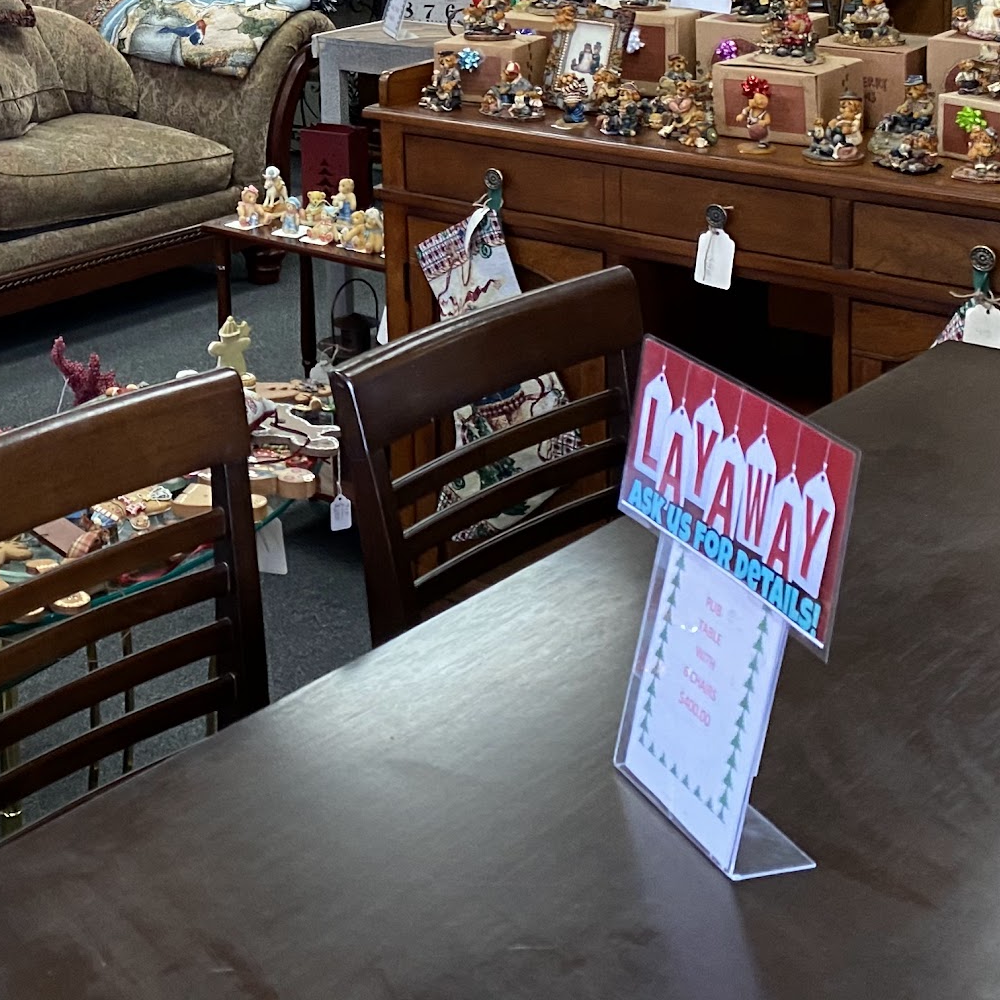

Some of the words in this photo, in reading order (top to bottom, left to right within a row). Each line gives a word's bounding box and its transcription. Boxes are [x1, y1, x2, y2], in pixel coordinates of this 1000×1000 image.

[424, 5, 435, 19] 7
[641, 397, 830, 582] LAYAWAY
[627, 479, 662, 526] ASK
[665, 507, 693, 543] US
[694, 520, 734, 572] FOR
[706, 596, 722, 617] PUB
[699, 619, 722, 646] TABLE
[696, 646, 716, 671] WITH
[683, 666, 689, 678] 6
[690, 671, 717, 702] CHAIRS
